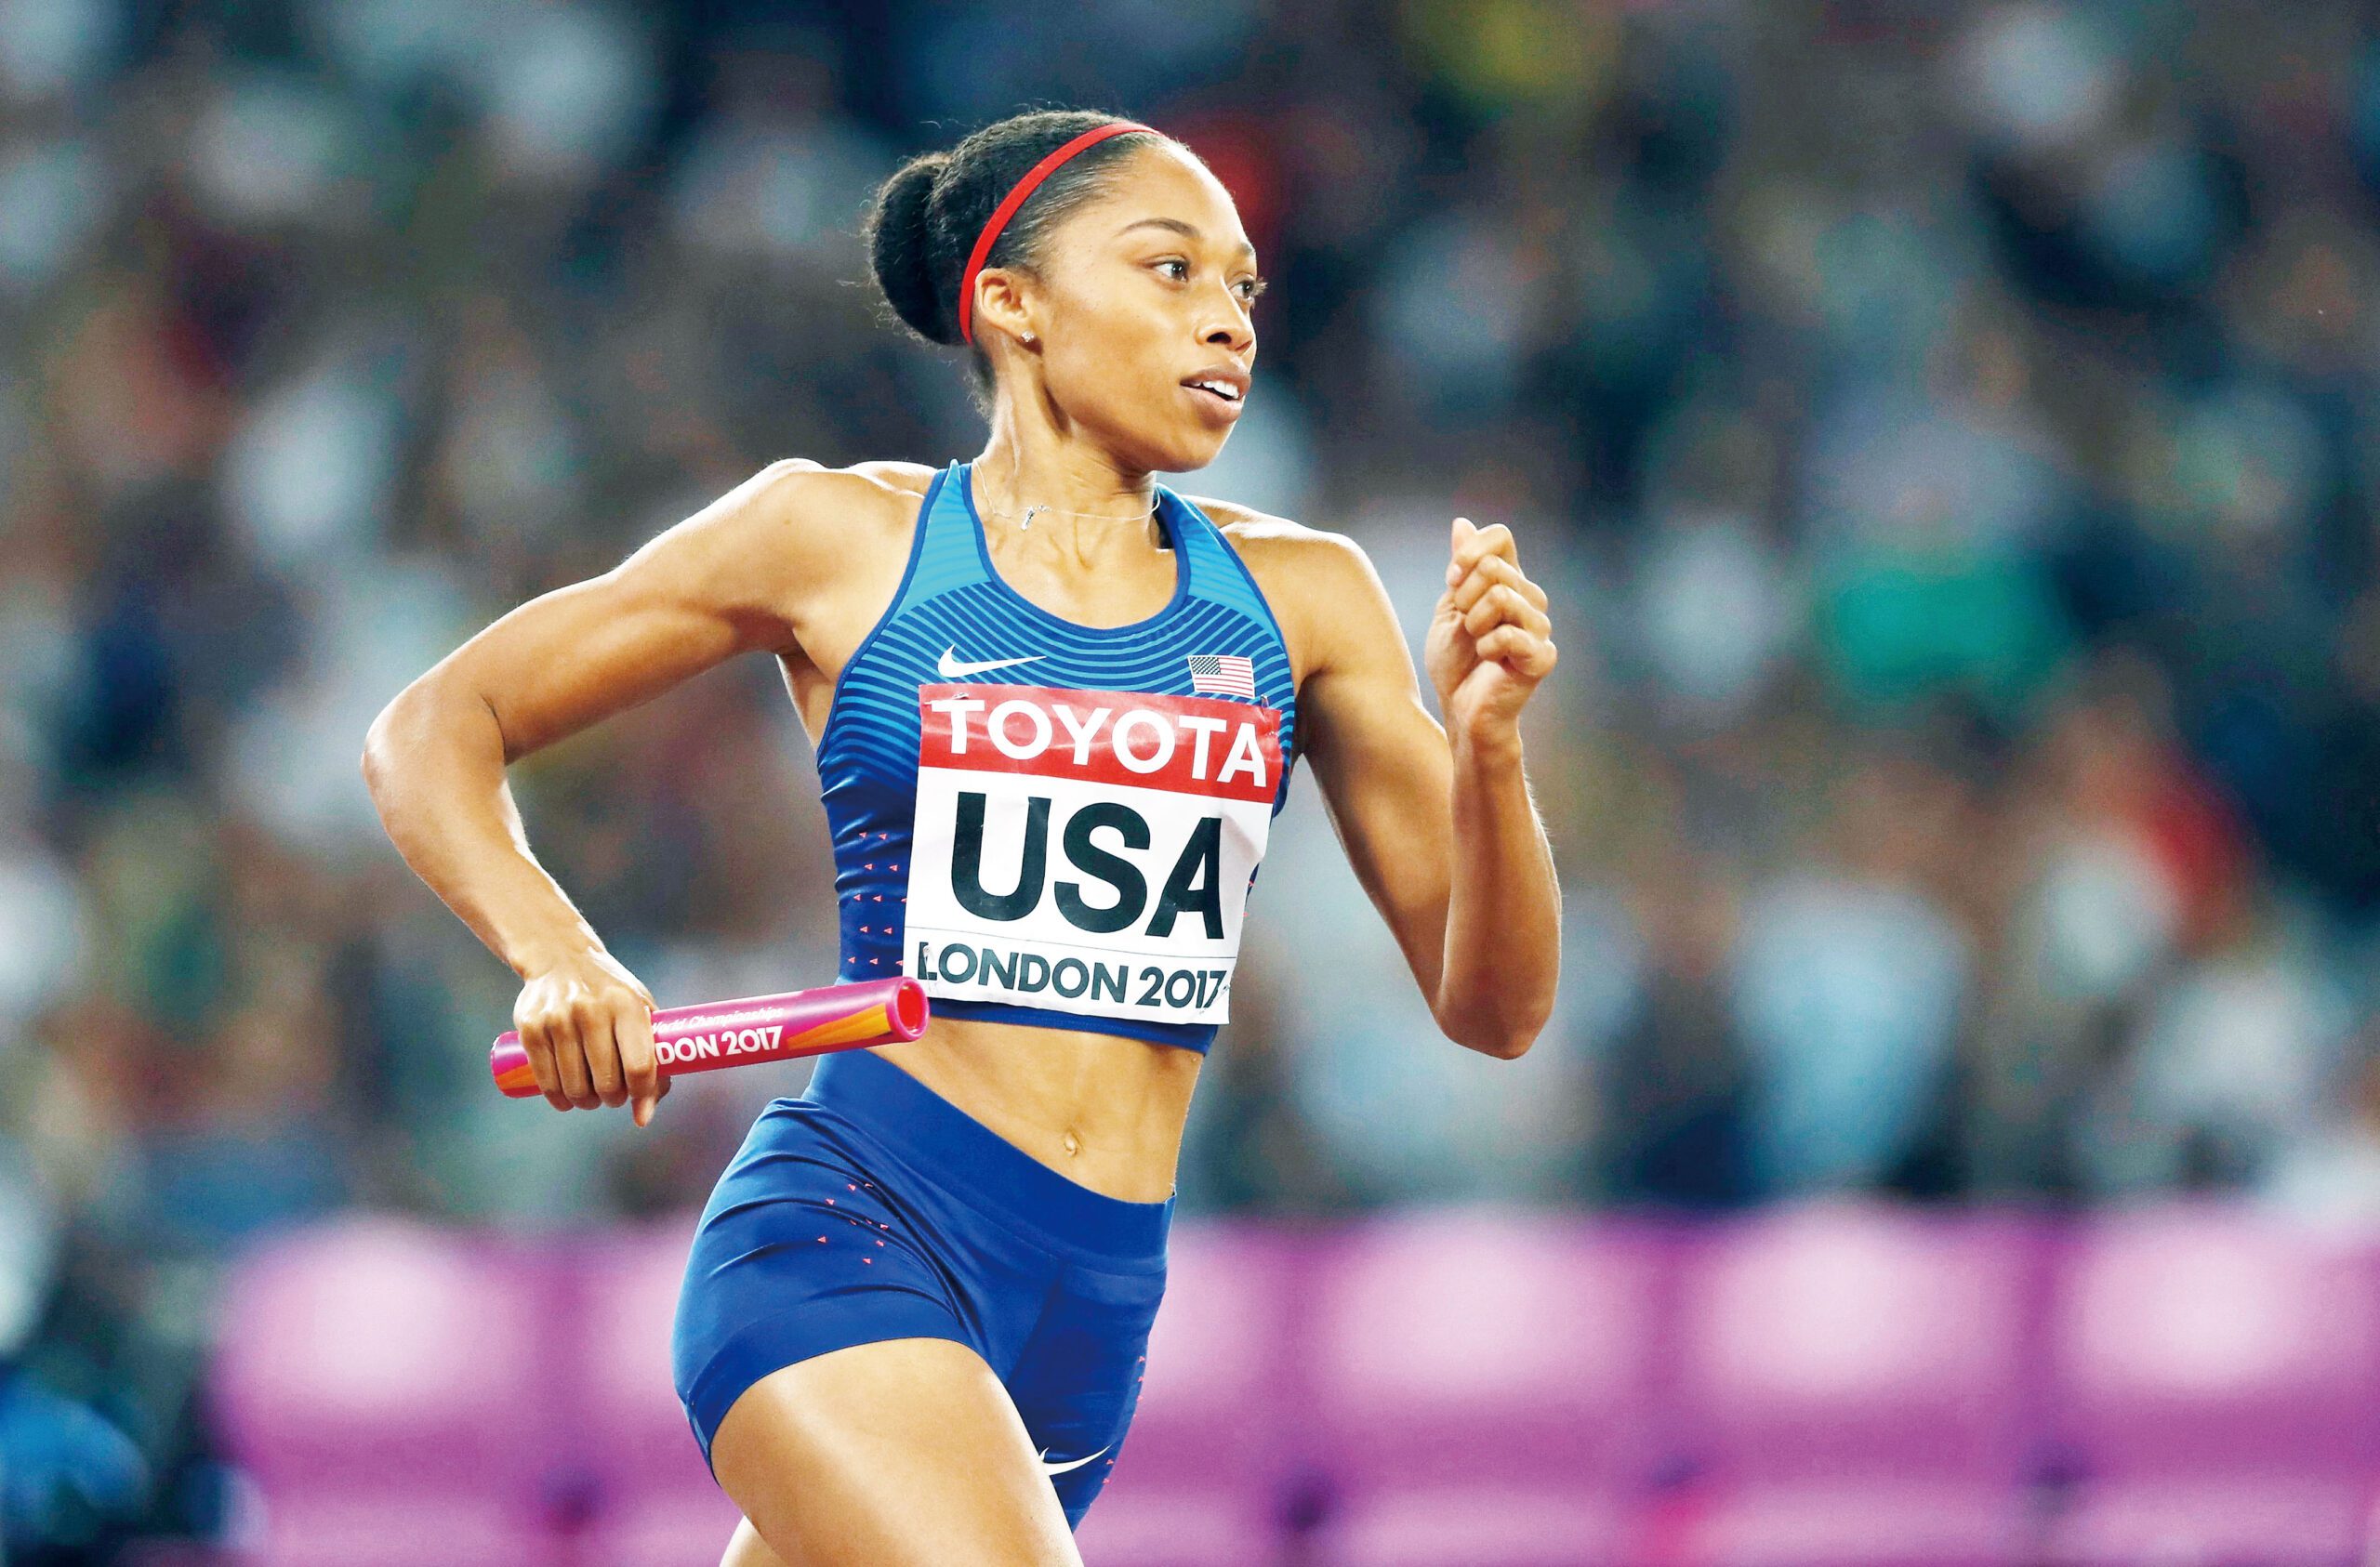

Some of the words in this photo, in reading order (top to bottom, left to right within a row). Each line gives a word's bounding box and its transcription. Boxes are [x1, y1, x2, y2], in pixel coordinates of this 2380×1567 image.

[932, 699, 1267, 787] TOYOTA
[951, 792, 1224, 940] USA
[918, 942, 1129, 1003] LONDON
[1135, 967, 1227, 1009] 2017
[655, 1034, 721, 1065] DON
[721, 1025, 783, 1056] 2017
[686, 1007, 785, 1027] Championships
